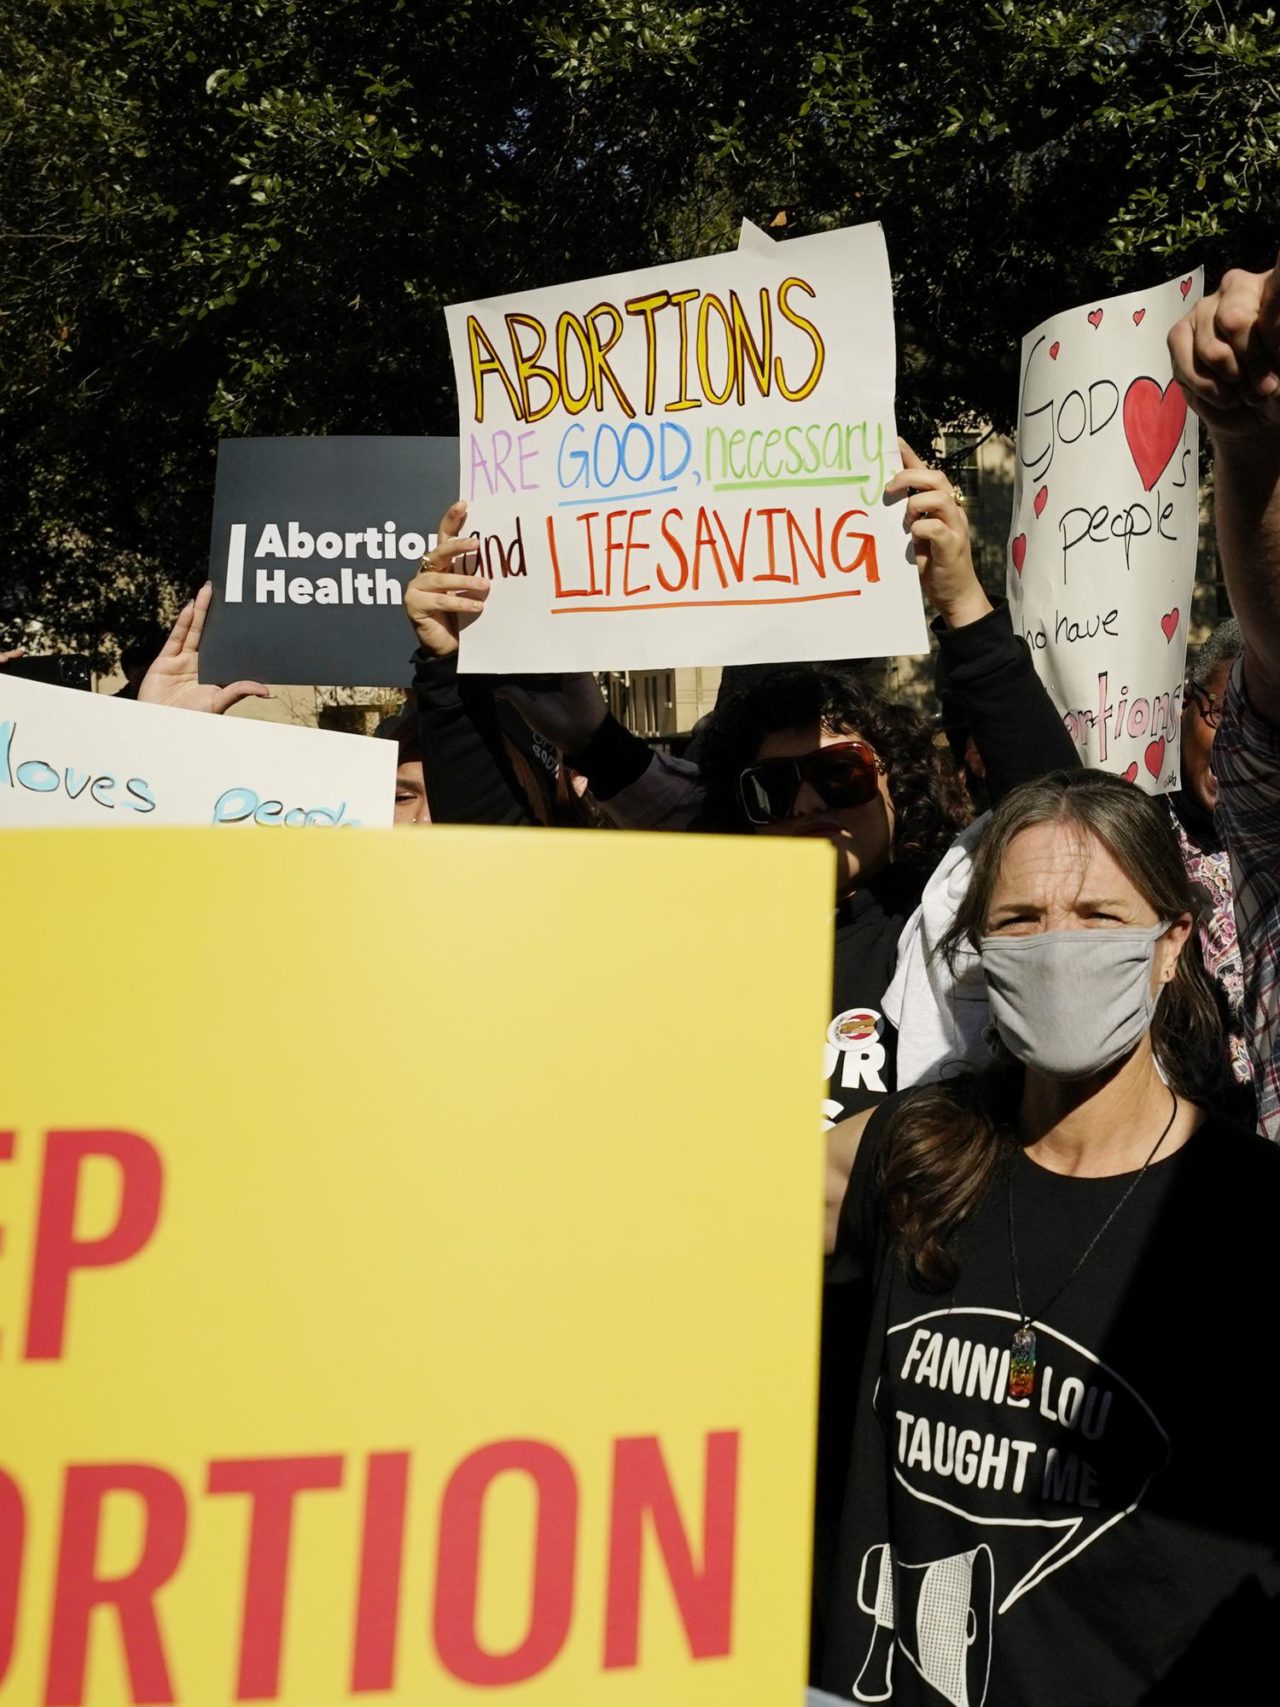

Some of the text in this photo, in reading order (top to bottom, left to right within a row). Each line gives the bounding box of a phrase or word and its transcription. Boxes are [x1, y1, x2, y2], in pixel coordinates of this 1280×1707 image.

[466, 276, 825, 424] ABORTIONS
[469, 430, 541, 501] ARE
[558, 421, 701, 489] GOOD,
[546, 507, 881, 598] LIFESAVING
[1058, 491, 1177, 585] people
[255, 569, 403, 605] Health
[1022, 609, 1119, 651] ho have
[1062, 671, 1182, 762] ortions
[0, 721, 156, 813] loves
[1039, 1366, 1113, 1441] LOU
[896, 1410, 1100, 1508] TAUGHT ME
[0, 1429, 741, 1707] RTION
